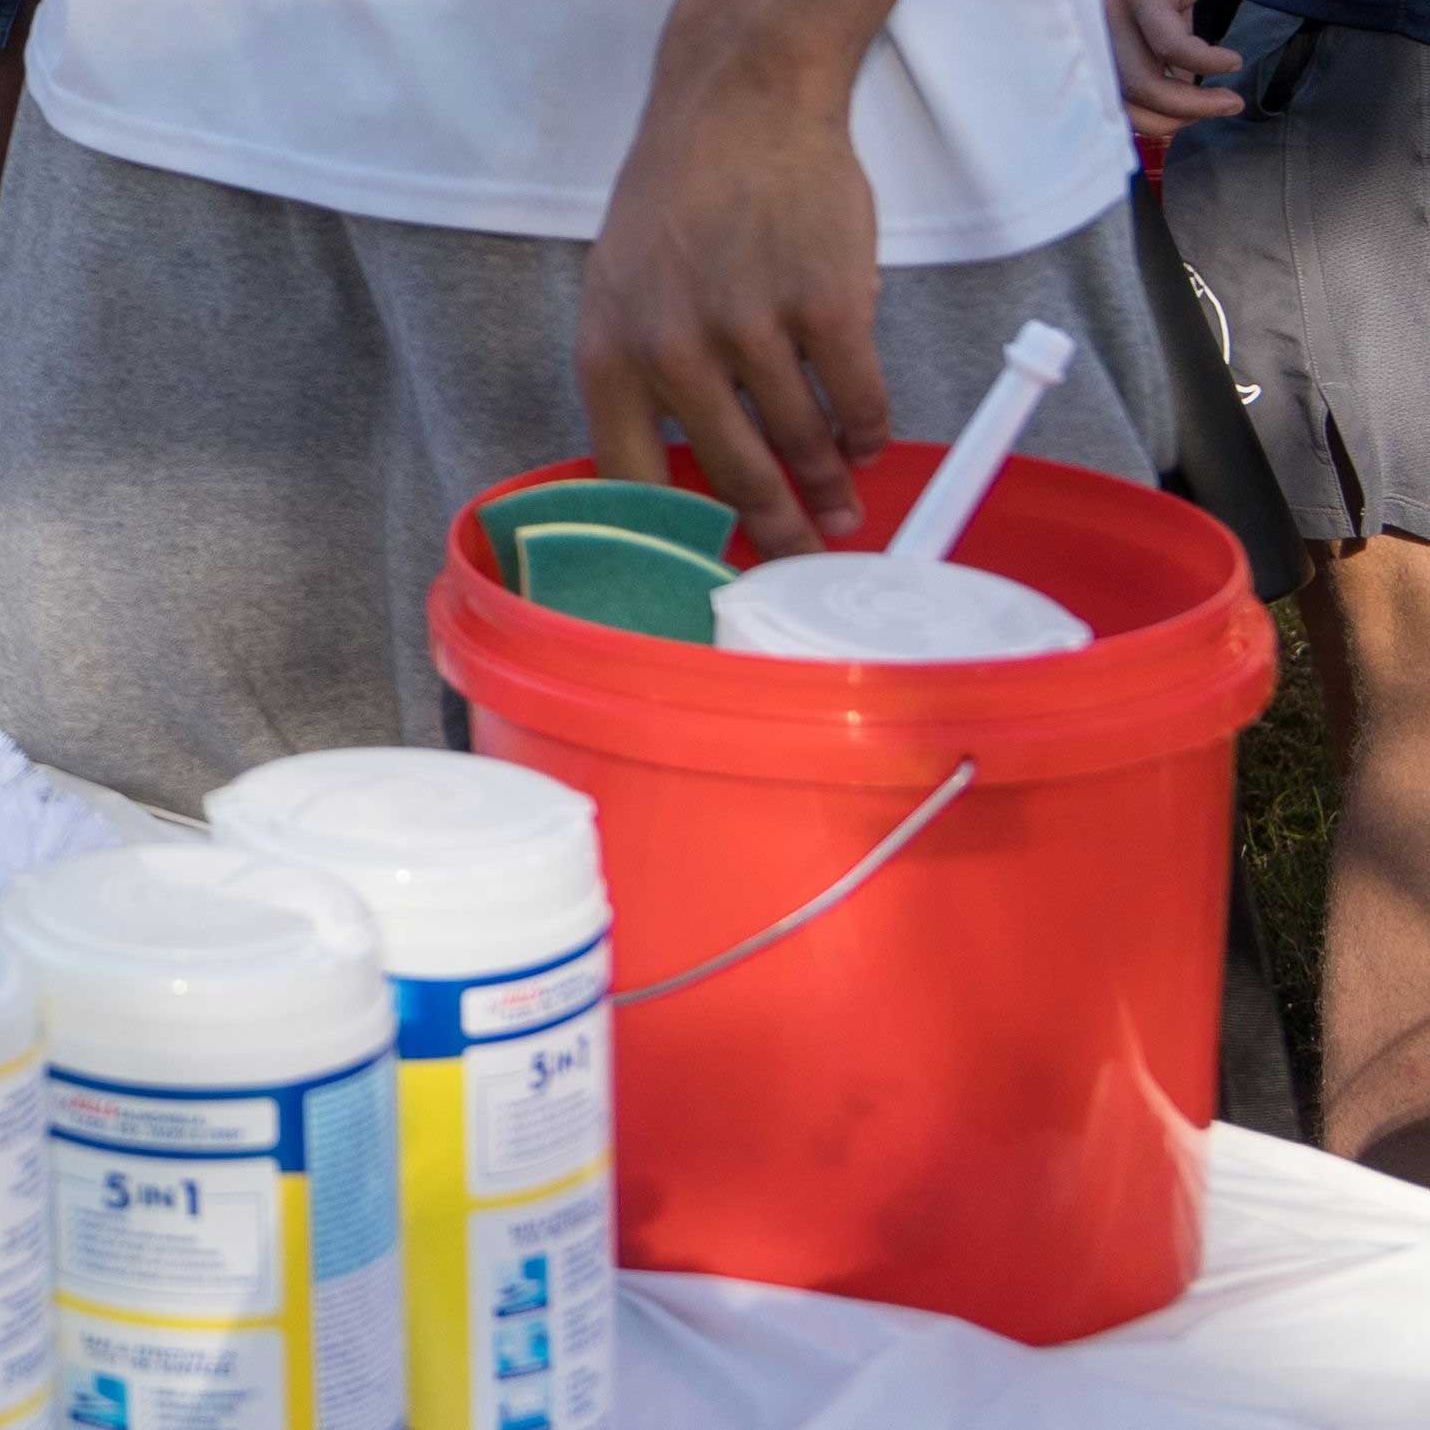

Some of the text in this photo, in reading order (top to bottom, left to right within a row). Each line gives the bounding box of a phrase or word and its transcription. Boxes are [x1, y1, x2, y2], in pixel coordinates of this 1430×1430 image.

[528, 1051, 549, 1090] 5
[102, 1171, 132, 1211] 5
[180, 1177, 201, 1218] 1
